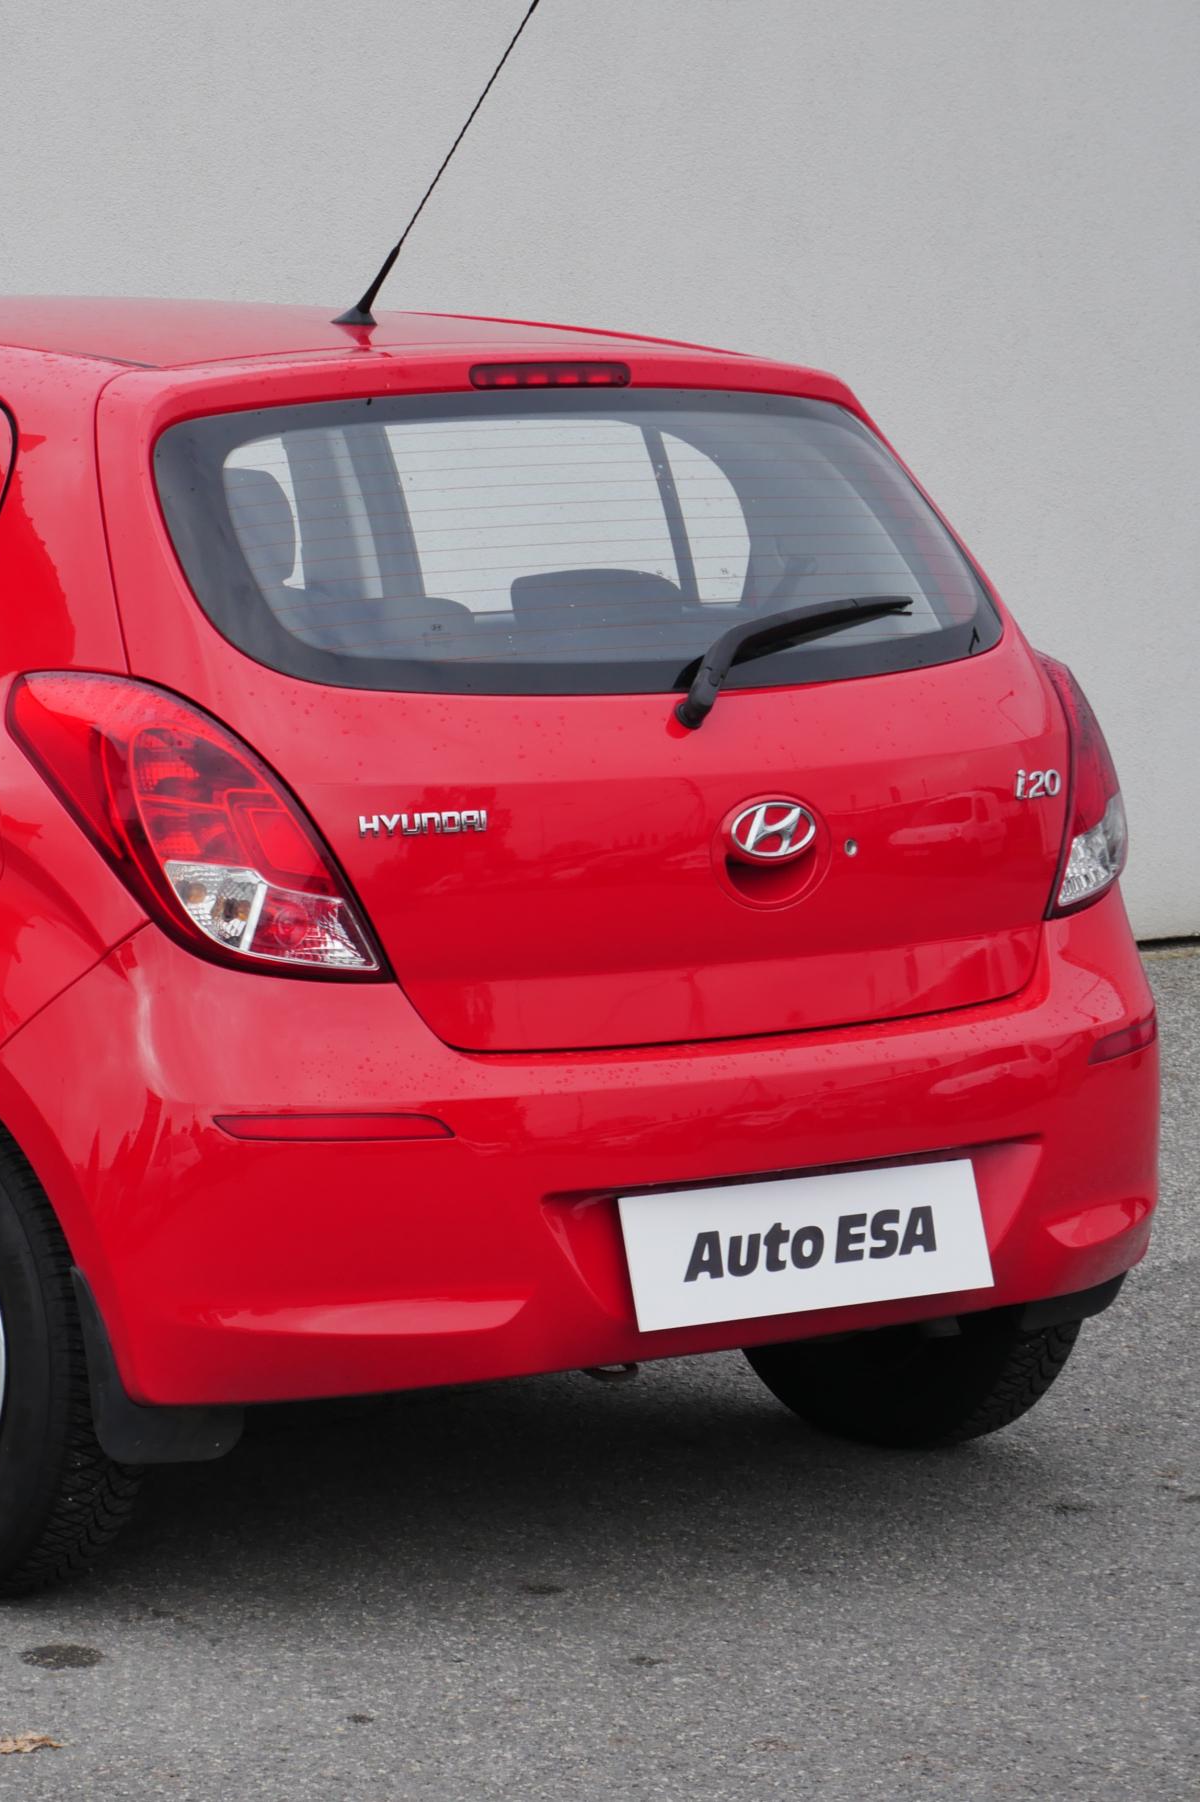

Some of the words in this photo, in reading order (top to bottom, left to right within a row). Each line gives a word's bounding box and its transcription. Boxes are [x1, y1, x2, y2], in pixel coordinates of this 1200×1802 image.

[1015, 769, 1061, 800] i20
[358, 810, 488, 837] HYUNDAI
[683, 1222, 825, 1283] Auto
[834, 1205, 937, 1264] ESA
